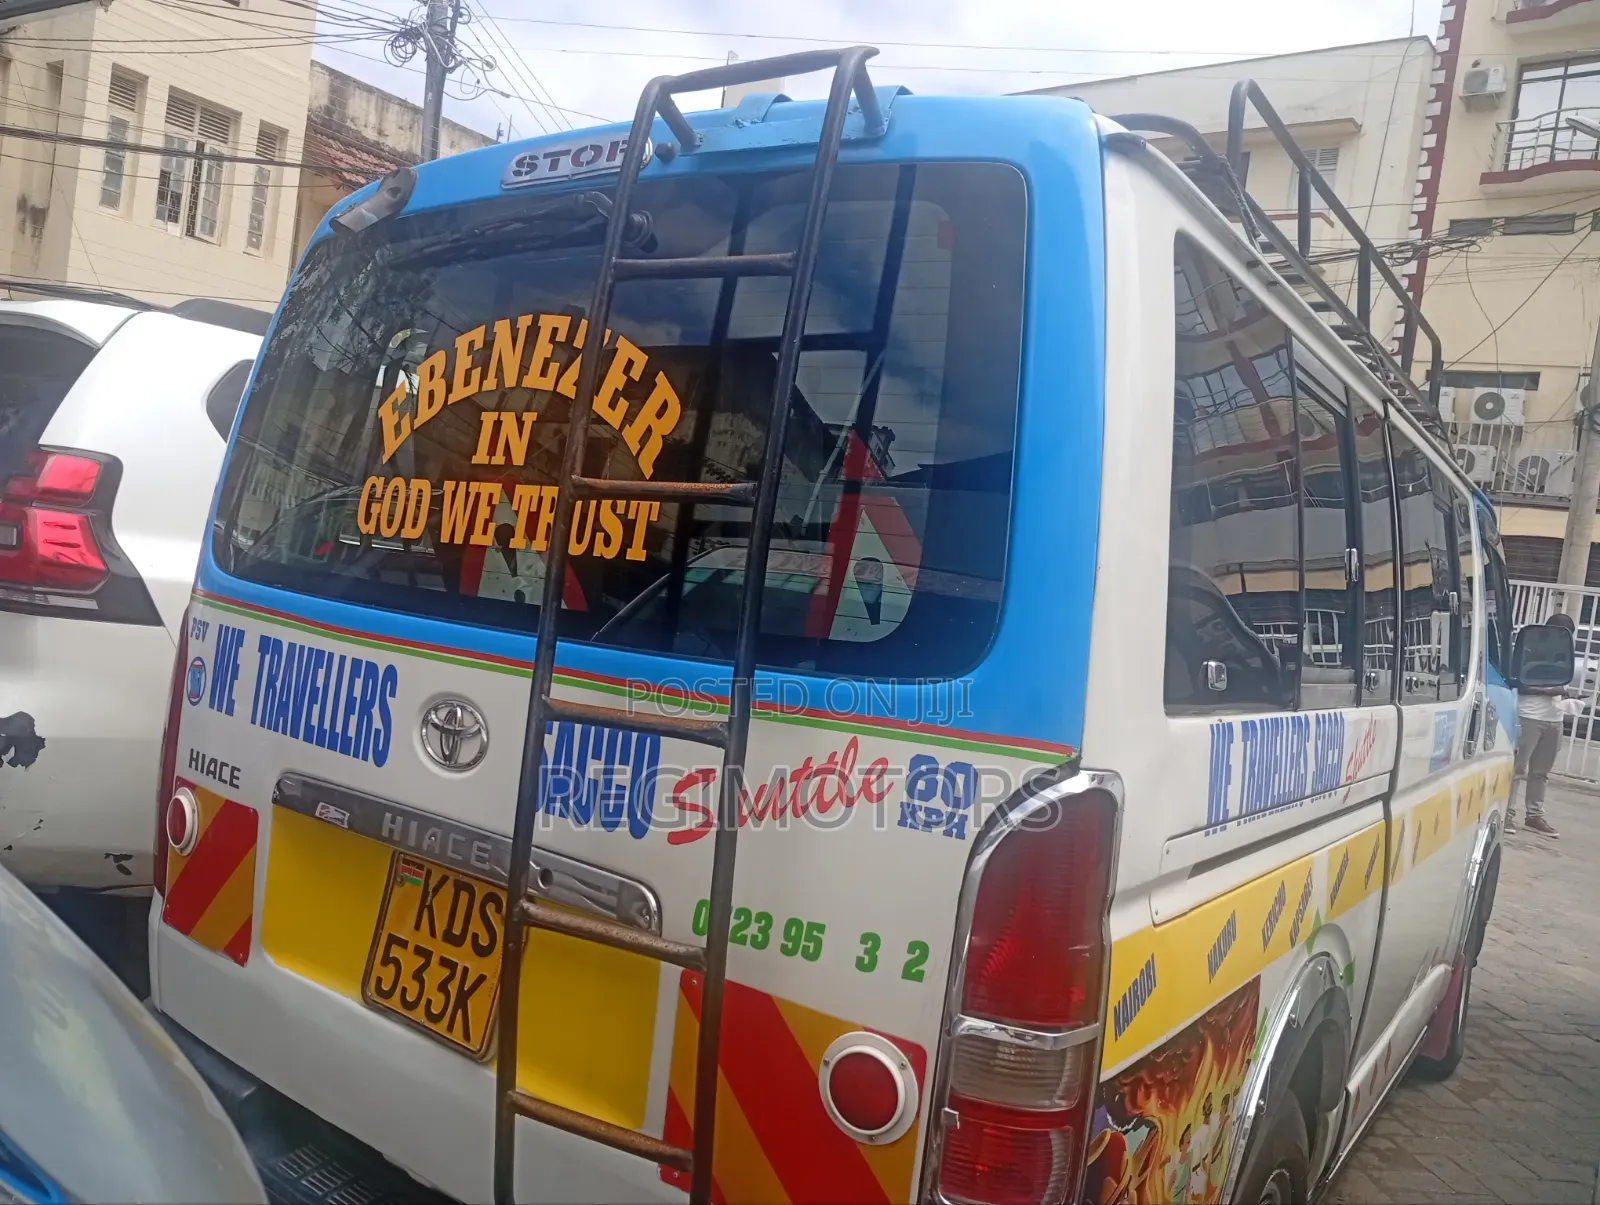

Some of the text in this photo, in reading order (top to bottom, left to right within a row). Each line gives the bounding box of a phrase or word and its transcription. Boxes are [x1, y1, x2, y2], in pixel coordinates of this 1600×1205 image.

[512, 139, 628, 177] STOP
[471, 411, 537, 466] IN
[357, 476, 432, 539] GOD
[439, 480, 503, 546] WE
[190, 617, 210, 642] PSV
[208, 623, 246, 717] WE
[250, 634, 399, 768] TRAVELLERS
[188, 748, 242, 790] HIACE
[905, 753, 979, 810] 80
[1203, 721, 1234, 838] WE
[1236, 714, 1311, 827] TRAVELLERS
[381, 811, 493, 871] HIACE
[897, 800, 969, 840] KPH
[413, 867, 504, 958] KDS
[692, 898, 773, 950] 023
[374, 932, 488, 1043] 533K
[1113, 951, 1158, 1043] NAIROBI
[1206, 908, 1237, 985] NAKURU
